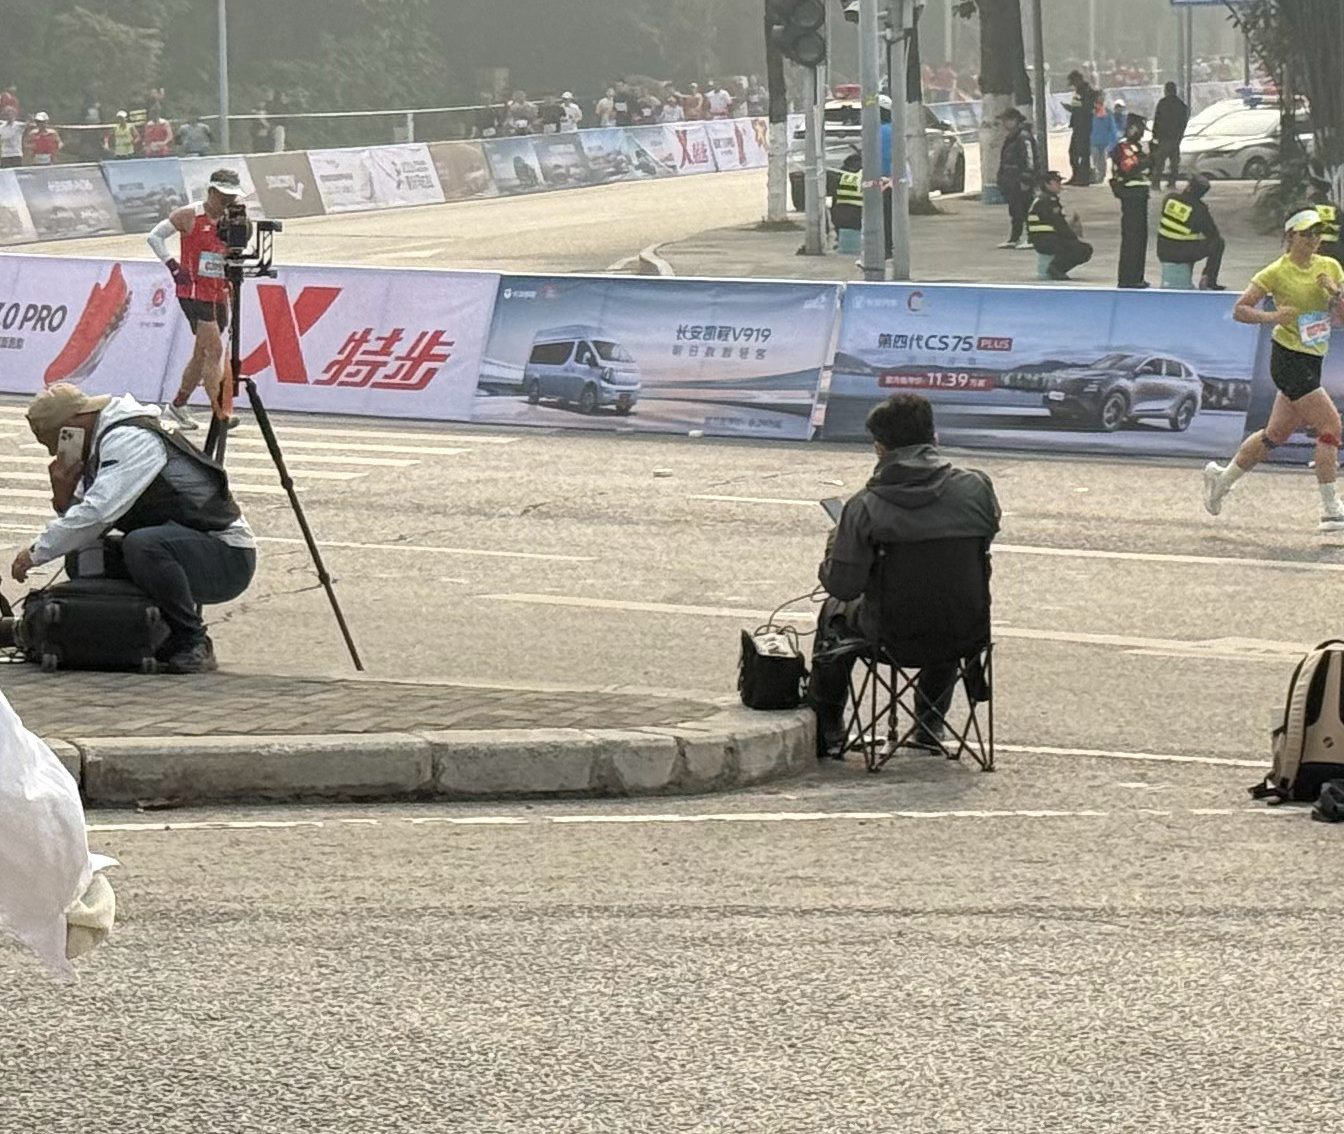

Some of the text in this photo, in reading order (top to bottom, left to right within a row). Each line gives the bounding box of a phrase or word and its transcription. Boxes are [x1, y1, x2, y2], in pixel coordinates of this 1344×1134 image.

[17, 304, 68, 333] PRO
[980, 341, 1010, 349] PLUS
[312, 327, 455, 391] 特步
[927, 372, 969, 387] 11.39
